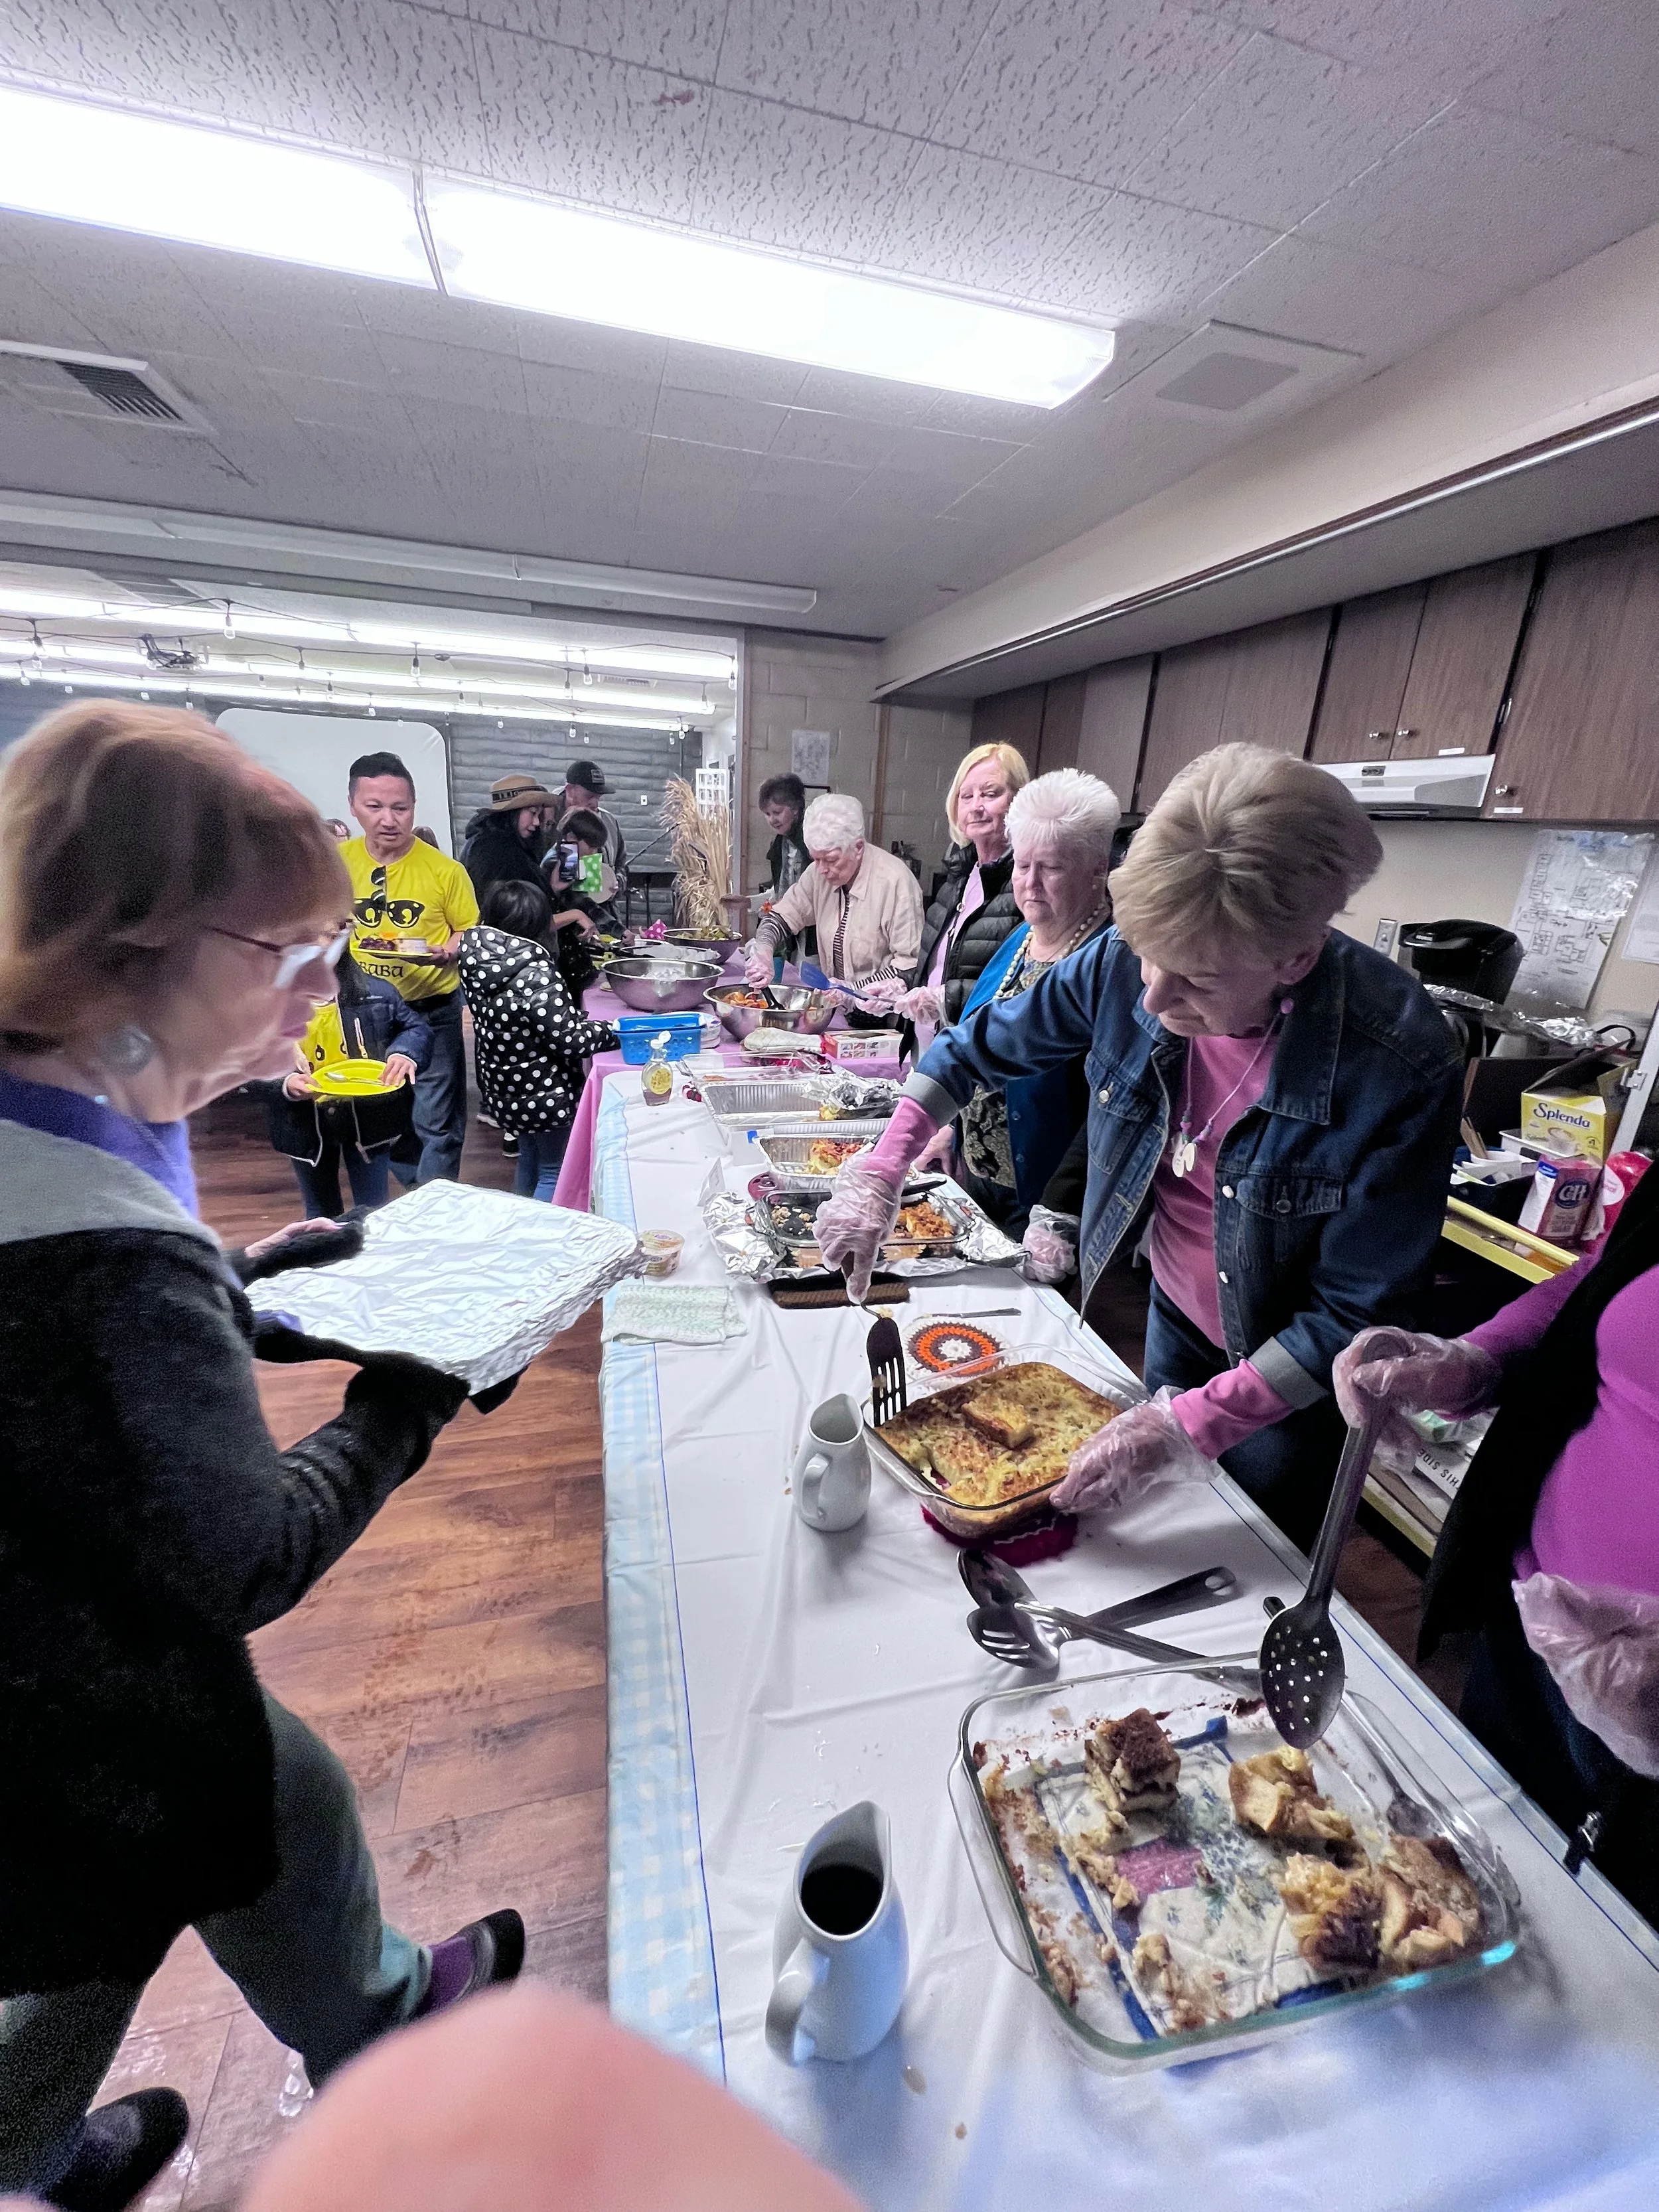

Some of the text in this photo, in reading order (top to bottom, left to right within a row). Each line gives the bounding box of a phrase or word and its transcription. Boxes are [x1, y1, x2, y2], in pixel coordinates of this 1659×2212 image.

[1534, 1103, 1591, 1128] Splenda
[1417, 1447, 1460, 1491] HIS SIDE
